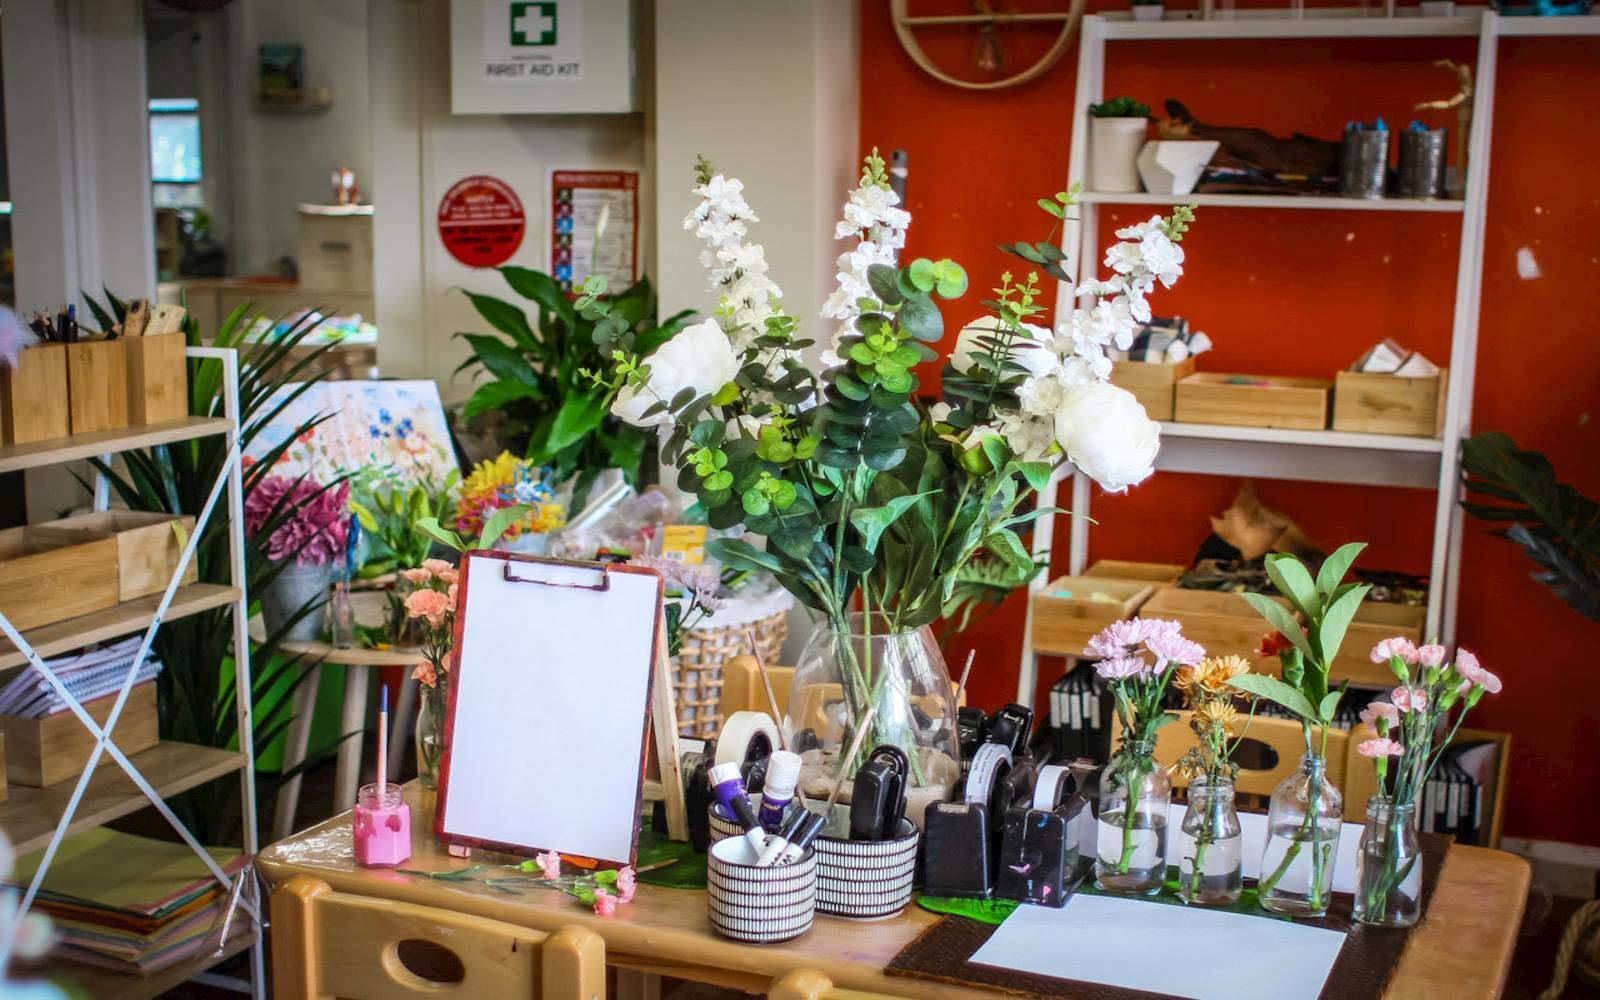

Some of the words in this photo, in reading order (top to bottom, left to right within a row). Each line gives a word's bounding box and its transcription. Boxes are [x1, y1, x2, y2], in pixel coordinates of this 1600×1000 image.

[486, 63, 525, 76] FIRST
[530, 63, 554, 76] AID
[558, 62, 580, 75] KIT
